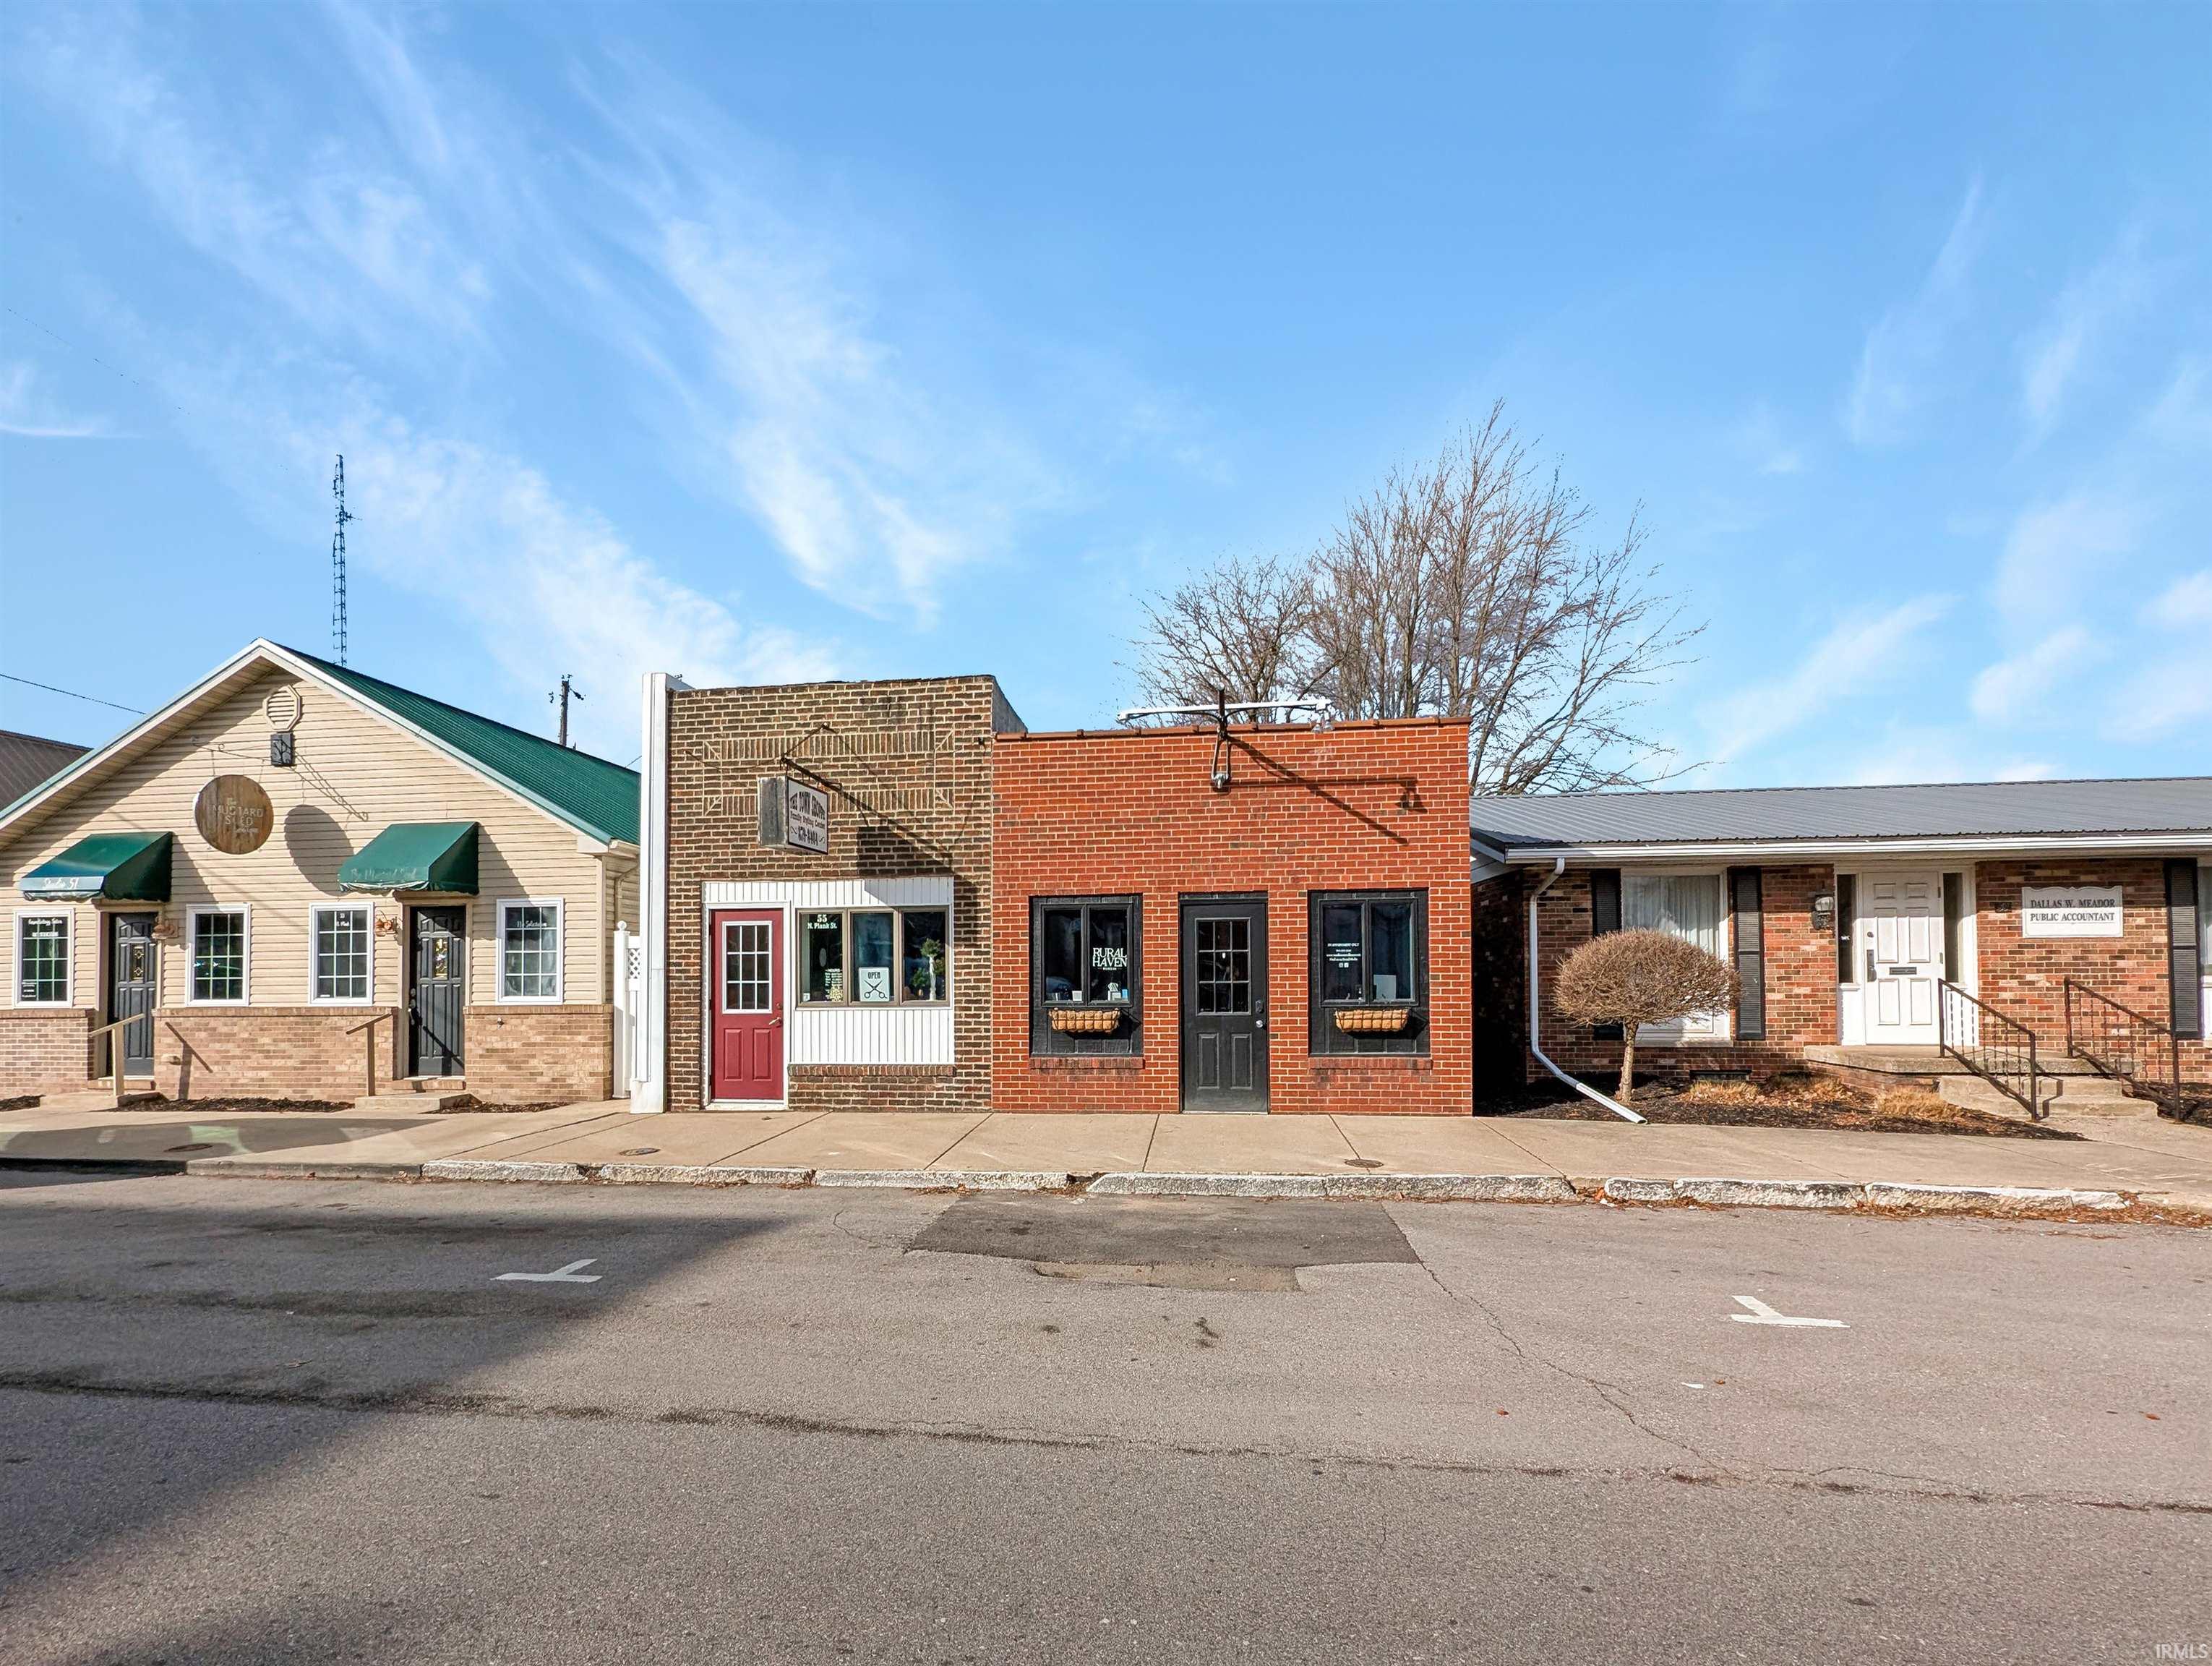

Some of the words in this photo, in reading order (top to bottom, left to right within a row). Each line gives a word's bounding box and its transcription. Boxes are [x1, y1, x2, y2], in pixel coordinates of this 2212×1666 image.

[212, 805, 264, 817] MUSTARD
[799, 792, 810, 815] TOWN
[811, 795, 826, 820] SHOPPE
[2031, 899, 2062, 908] DALLAS
[2064, 899, 2075, 908] W.
[2078, 899, 2115, 908] MEADOR
[817, 914, 828, 923] 55
[2030, 913, 2059, 921] PUBLIC
[2062, 913, 2115, 921] ACCOUNTANT
[1092, 947, 1127, 957] RURAL
[1092, 957, 1128, 967] HAVEN
